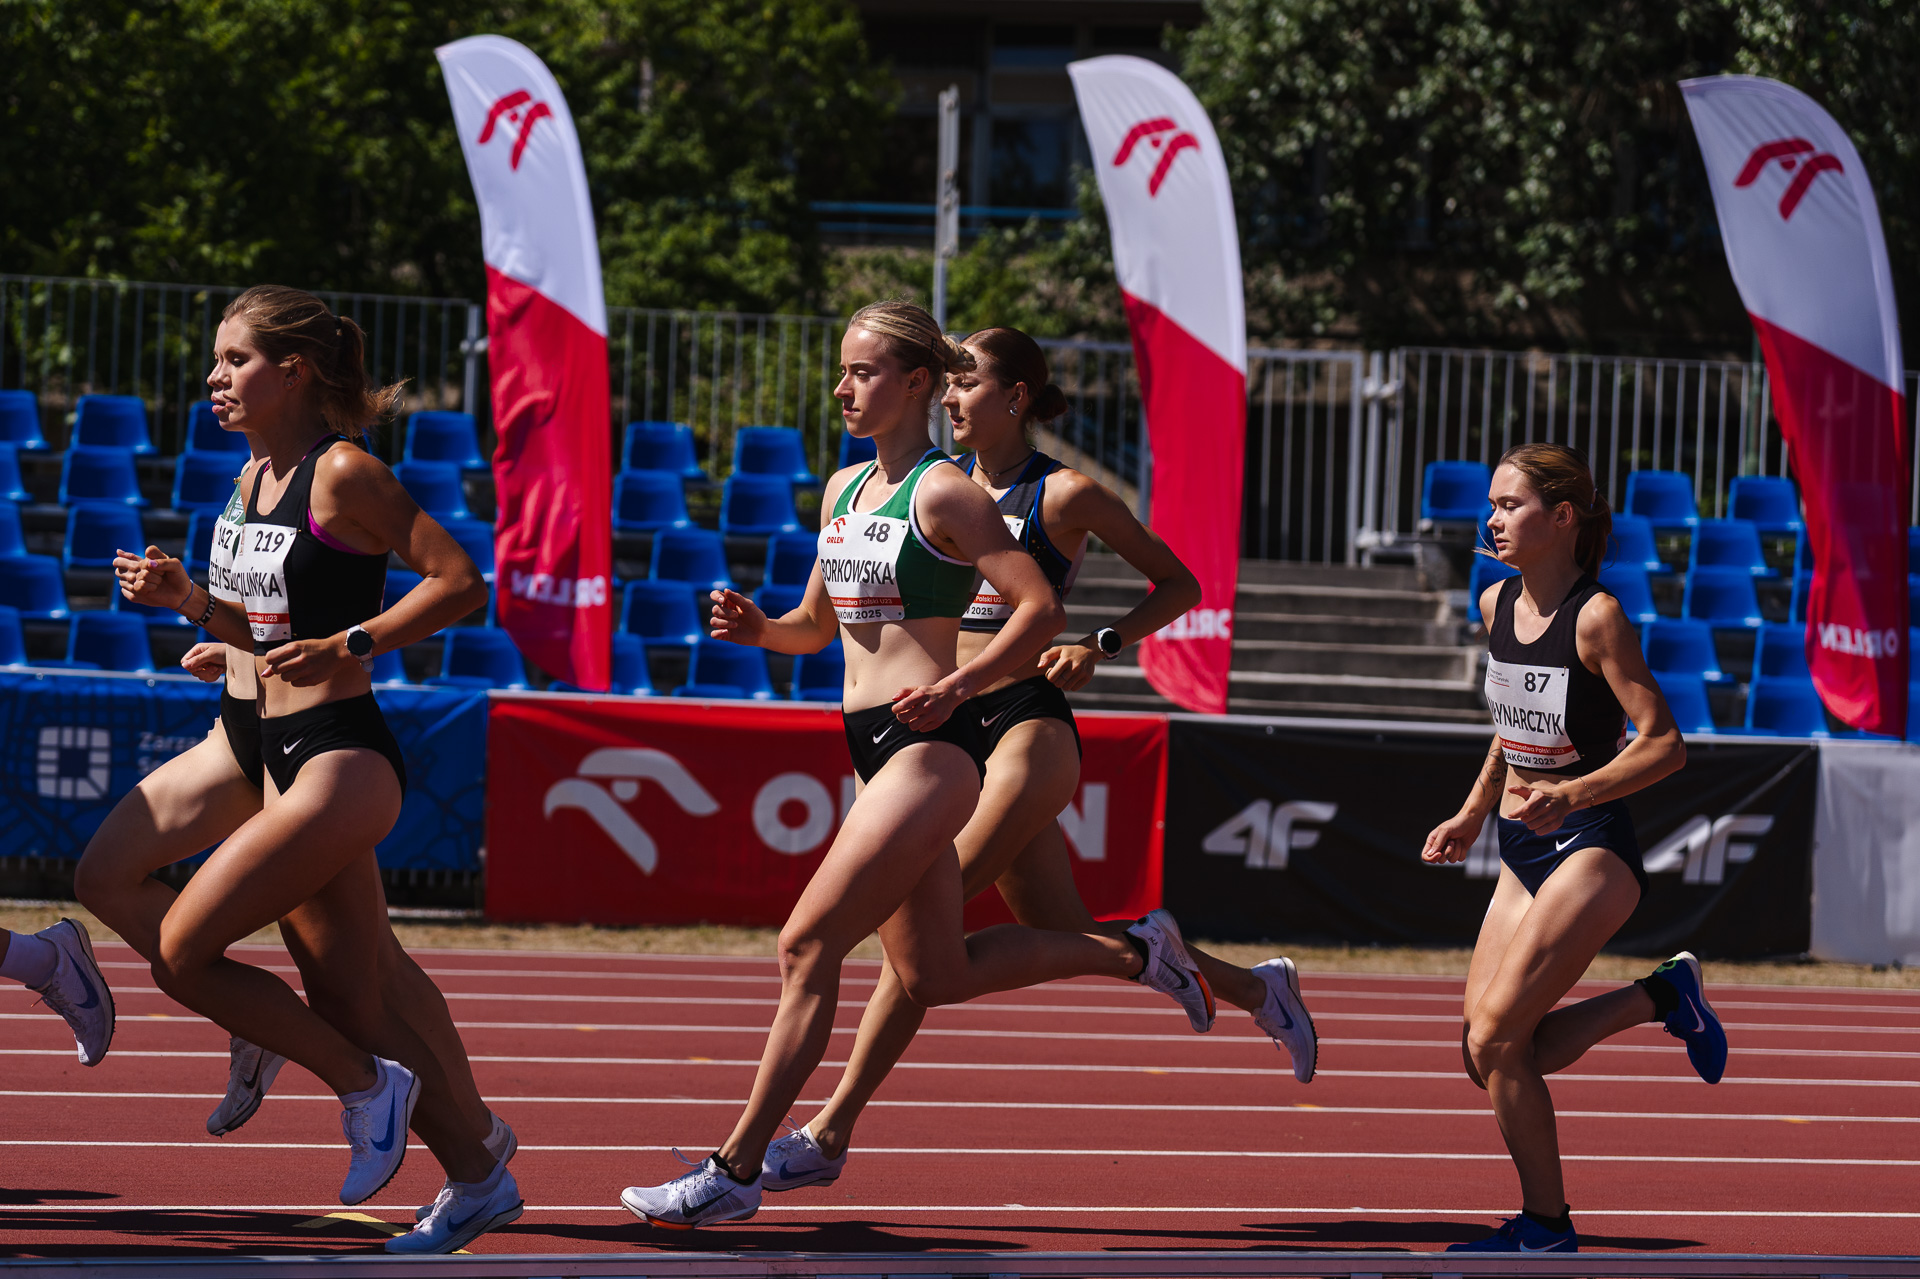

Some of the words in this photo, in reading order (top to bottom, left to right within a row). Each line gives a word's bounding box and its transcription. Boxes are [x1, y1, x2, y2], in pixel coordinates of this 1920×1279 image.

[864, 521, 890, 542] 48
[217, 525, 233, 550] 142
[254, 530, 285, 553] 219
[826, 536, 844, 544] ORLEN
[820, 558, 894, 585] BORKOWSKA
[976, 595, 992, 603] Polski
[855, 609, 882, 619] 2025
[971, 606, 993, 615] 2025
[264, 614, 278, 622] U23
[1524, 671, 1551, 694] 87
[1506, 741, 1535, 752] Mistrzostwa
[1533, 757, 1557, 765] 2025
[1202, 798, 1338, 870] 4F
